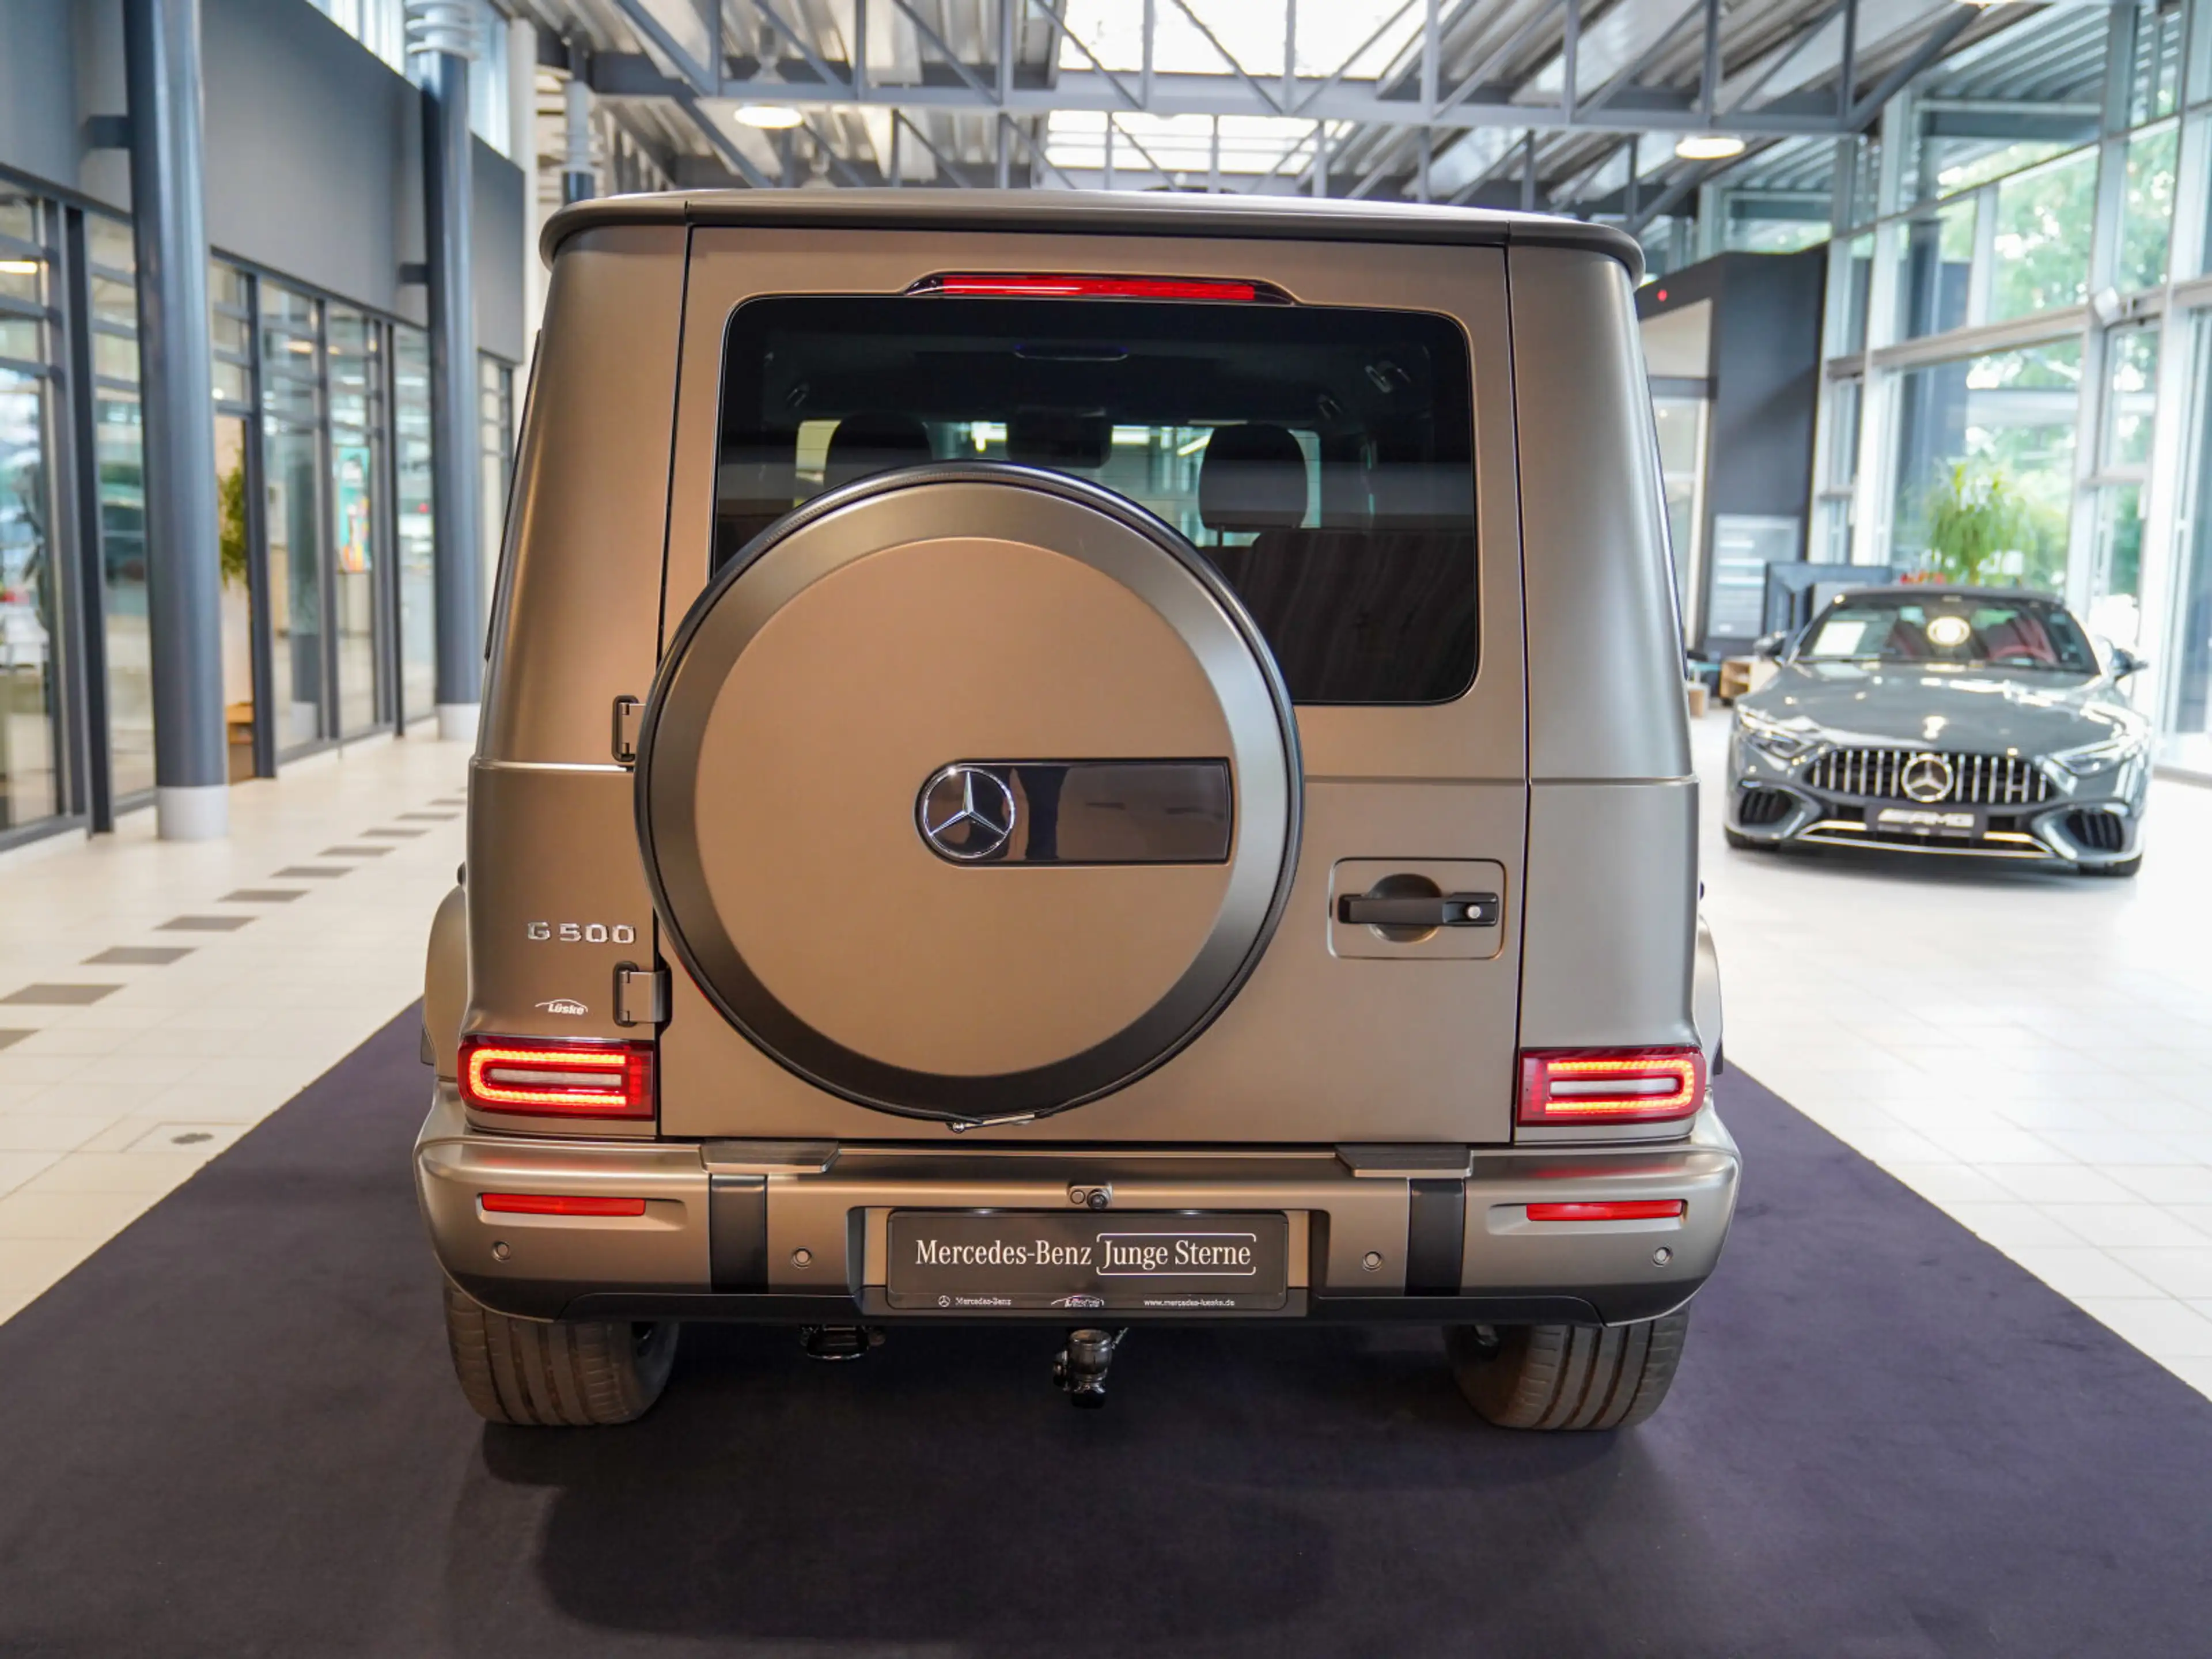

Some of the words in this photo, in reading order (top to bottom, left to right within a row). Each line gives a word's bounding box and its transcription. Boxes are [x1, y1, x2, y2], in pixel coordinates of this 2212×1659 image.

[527, 921, 551, 941] G
[559, 923, 636, 944] 500
[547, 1003, 585, 1016] Lüske
[915, 1239, 1093, 1265] Mercedes-Benz
[1103, 1240, 1169, 1271] Junge
[1175, 1239, 1251, 1266] Sterne
